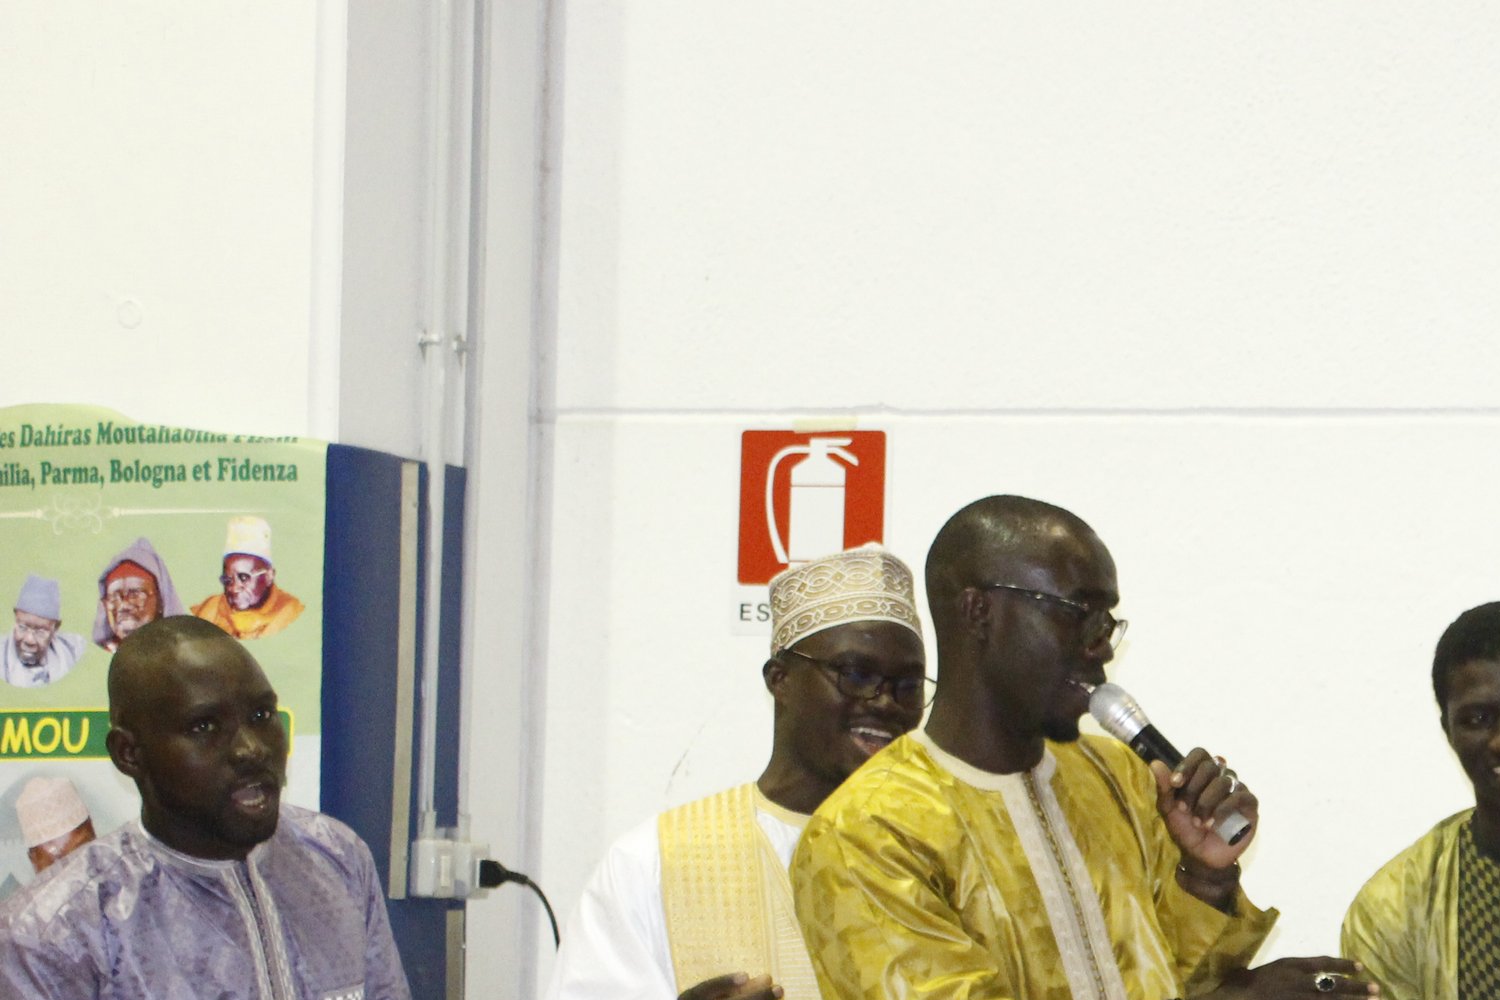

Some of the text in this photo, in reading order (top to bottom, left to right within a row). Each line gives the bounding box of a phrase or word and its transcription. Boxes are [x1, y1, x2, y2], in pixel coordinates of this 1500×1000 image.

[20, 423, 91, 447] Dahiras
[41, 461, 104, 489] Parma,
[110, 459, 187, 488] Bologna
[192, 460, 212, 482] et
[217, 457, 298, 482] Fidenza
[0, 717, 90, 754] MOU
